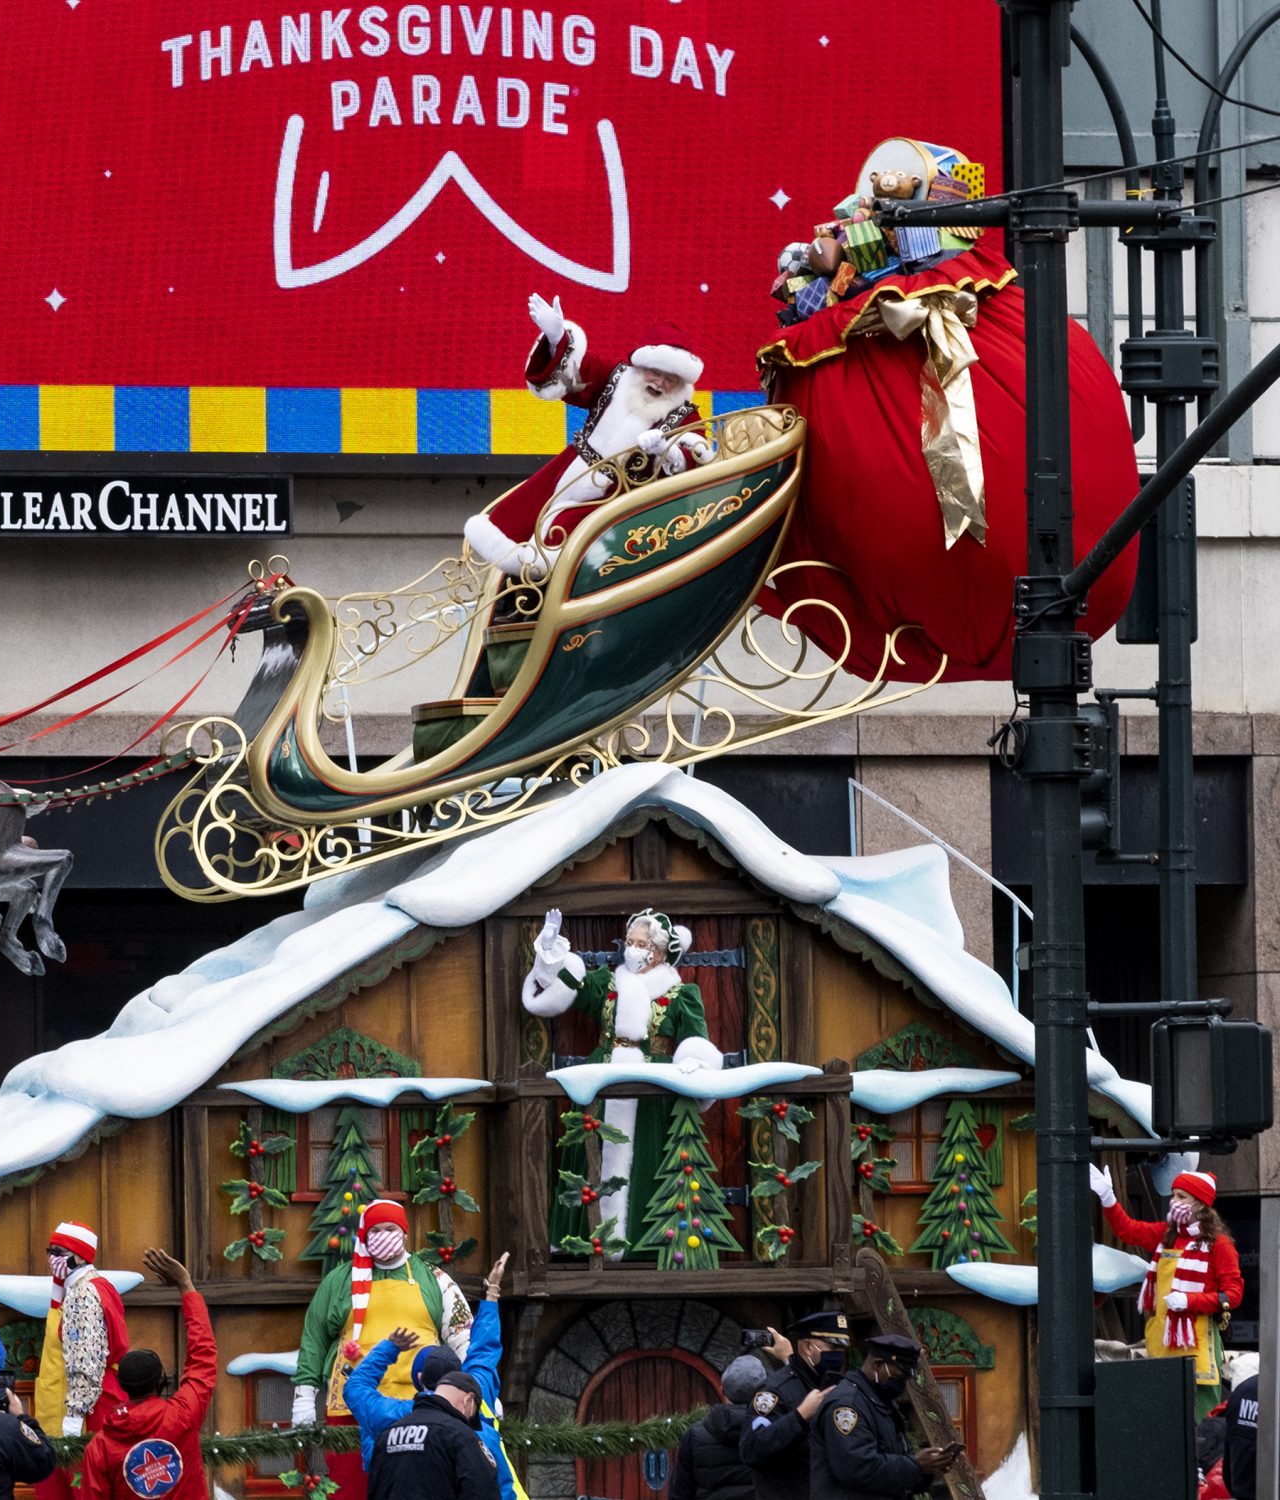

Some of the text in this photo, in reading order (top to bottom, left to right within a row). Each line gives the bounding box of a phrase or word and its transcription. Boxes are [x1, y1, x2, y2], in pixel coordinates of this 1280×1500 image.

[162, 5, 735, 97] THANKSGIVING DAY
[330, 74, 570, 135] PARADE
[1239, 1398, 1259, 1421] NYP
[387, 1425, 428, 1446] NYPD
